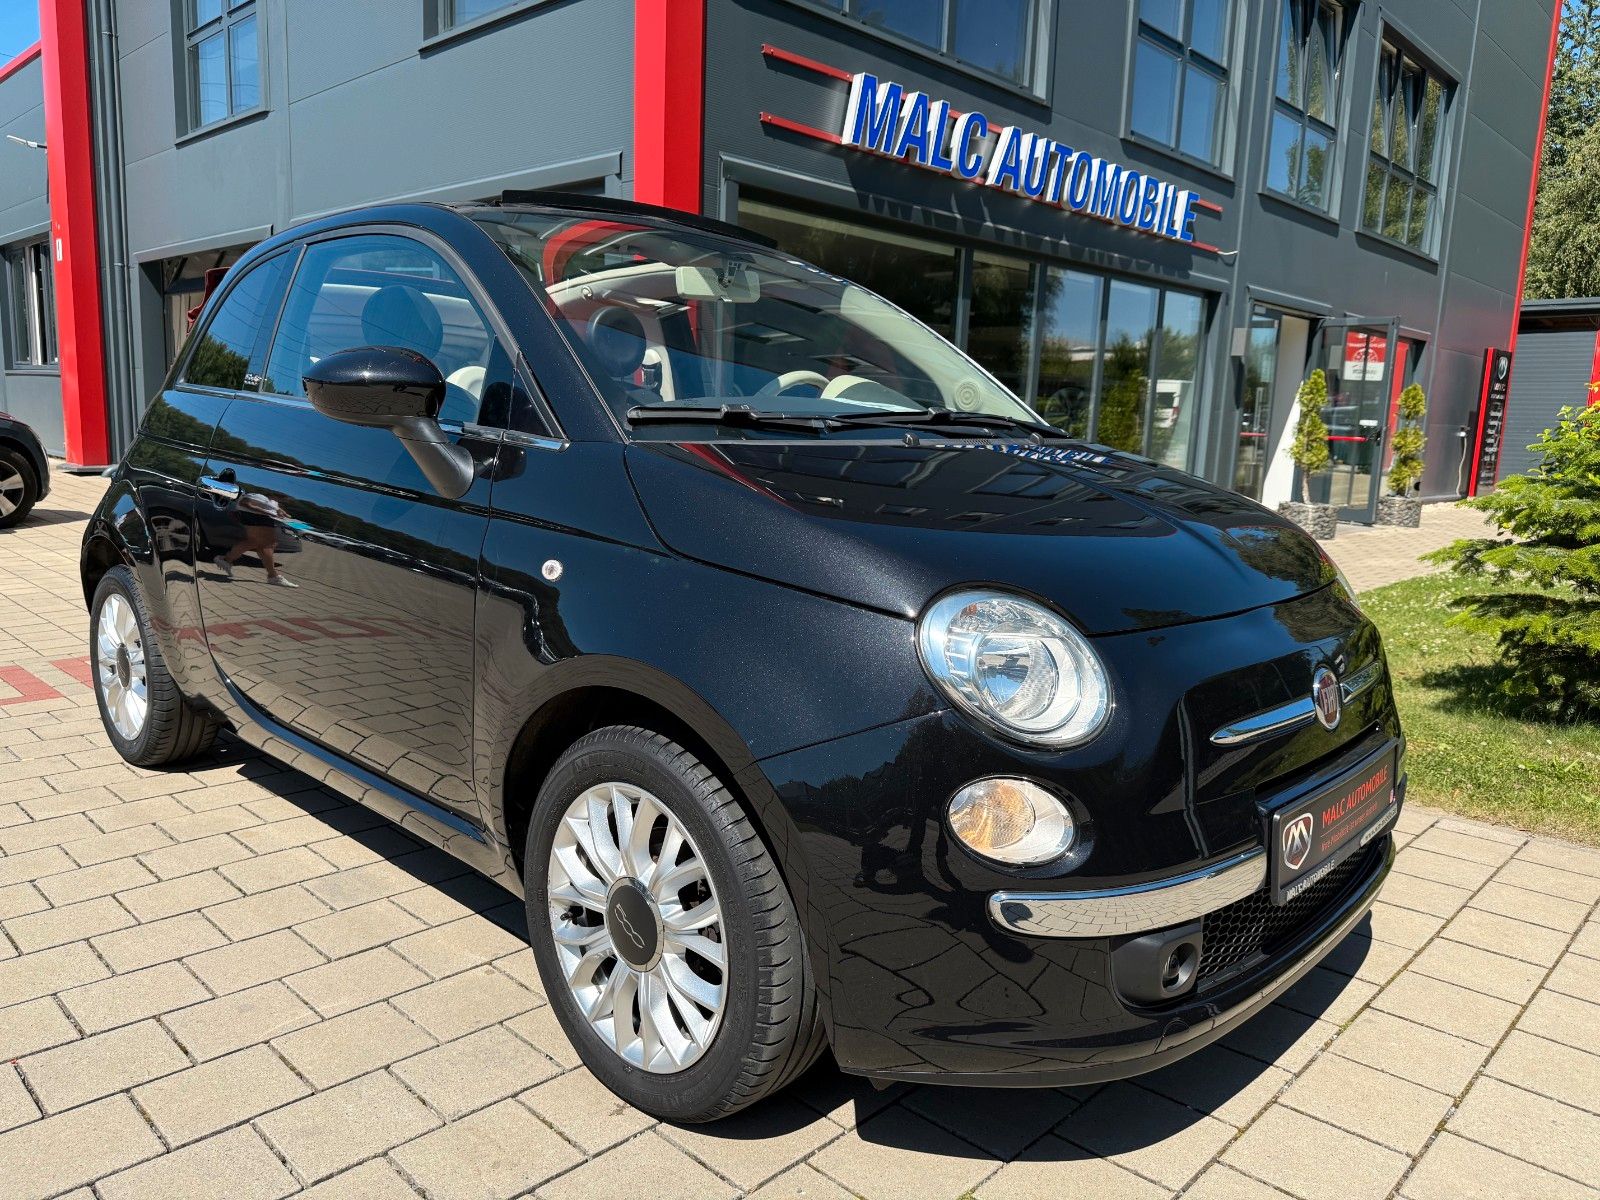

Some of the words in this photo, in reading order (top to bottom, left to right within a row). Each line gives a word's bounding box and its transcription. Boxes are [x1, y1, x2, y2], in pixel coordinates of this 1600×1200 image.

[843, 72, 988, 179] MALC
[988, 125, 1200, 242] AUTOMOBILE
[1322, 797, 1345, 829] MALC
[1345, 764, 1388, 812] AUTOMOBILE
